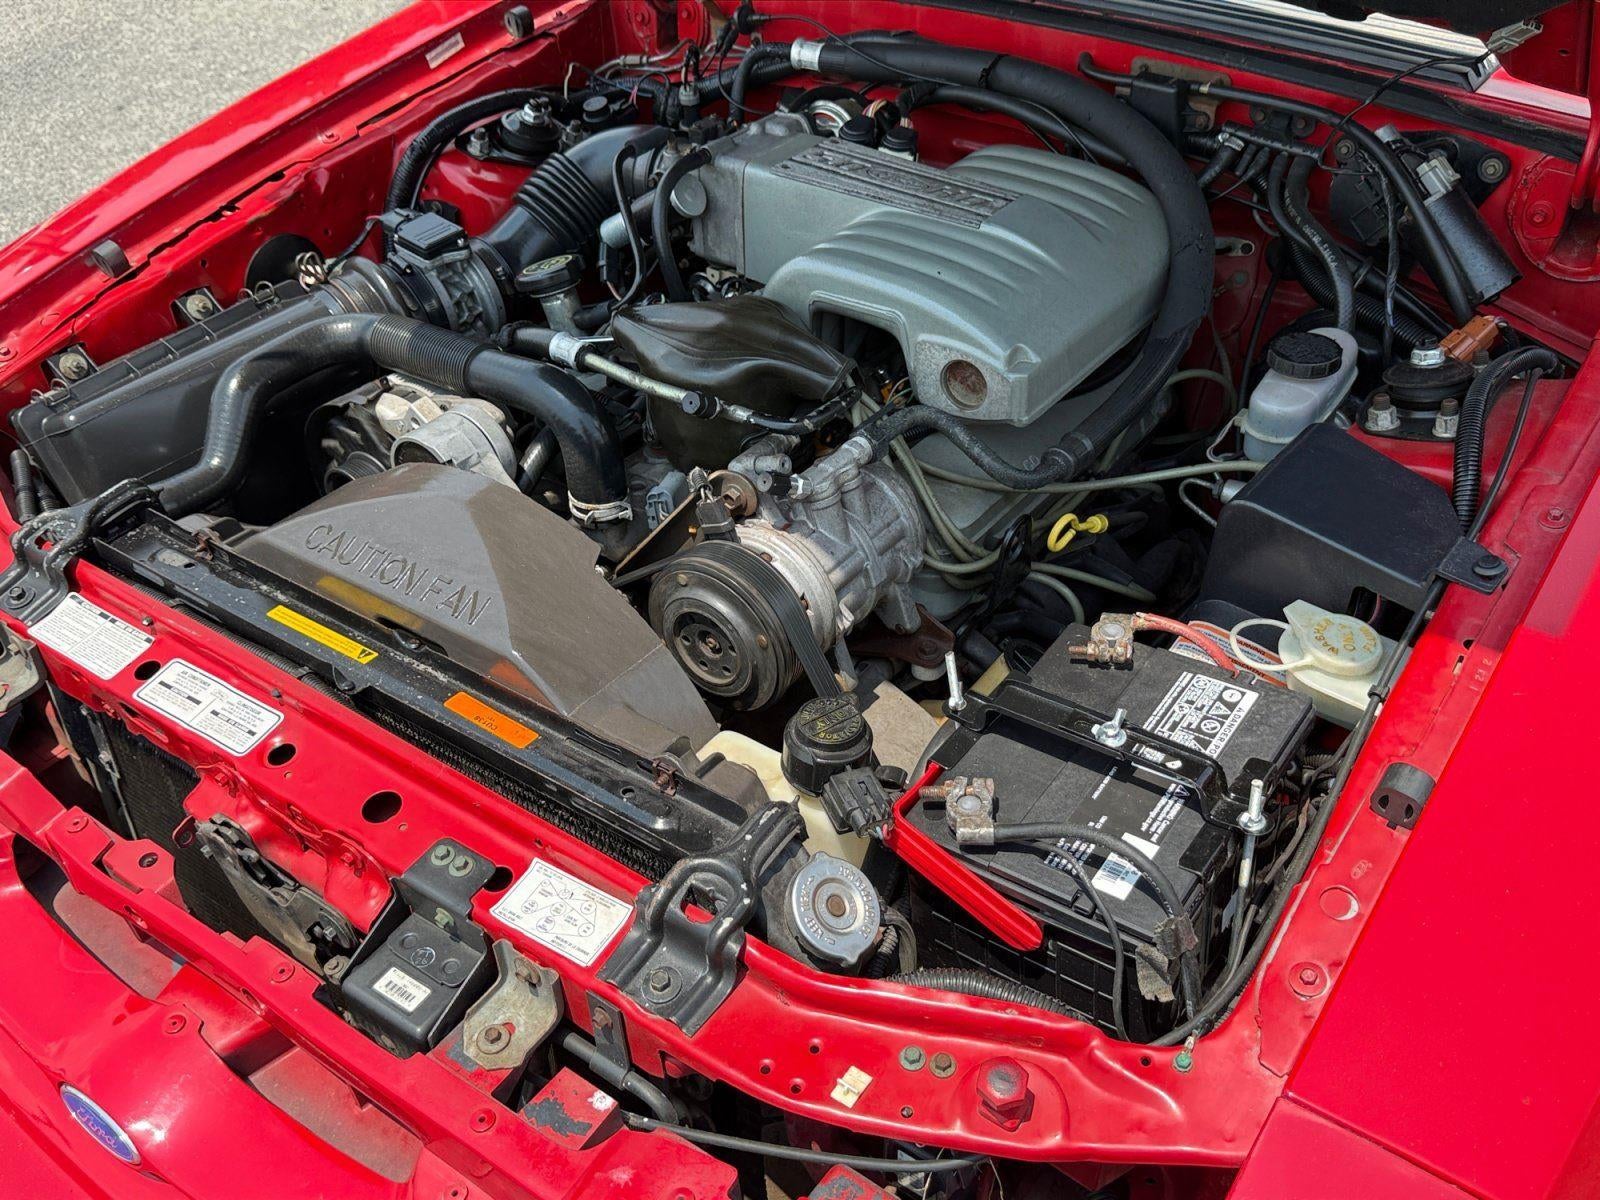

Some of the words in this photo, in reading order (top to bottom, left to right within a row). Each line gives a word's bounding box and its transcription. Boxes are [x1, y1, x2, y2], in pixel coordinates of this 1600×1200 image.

[304, 524, 429, 596] CAUTION
[420, 575, 492, 627] FAN
[1236, 639, 1265, 655] ARNING
[804, 916, 825, 940] KEEP
